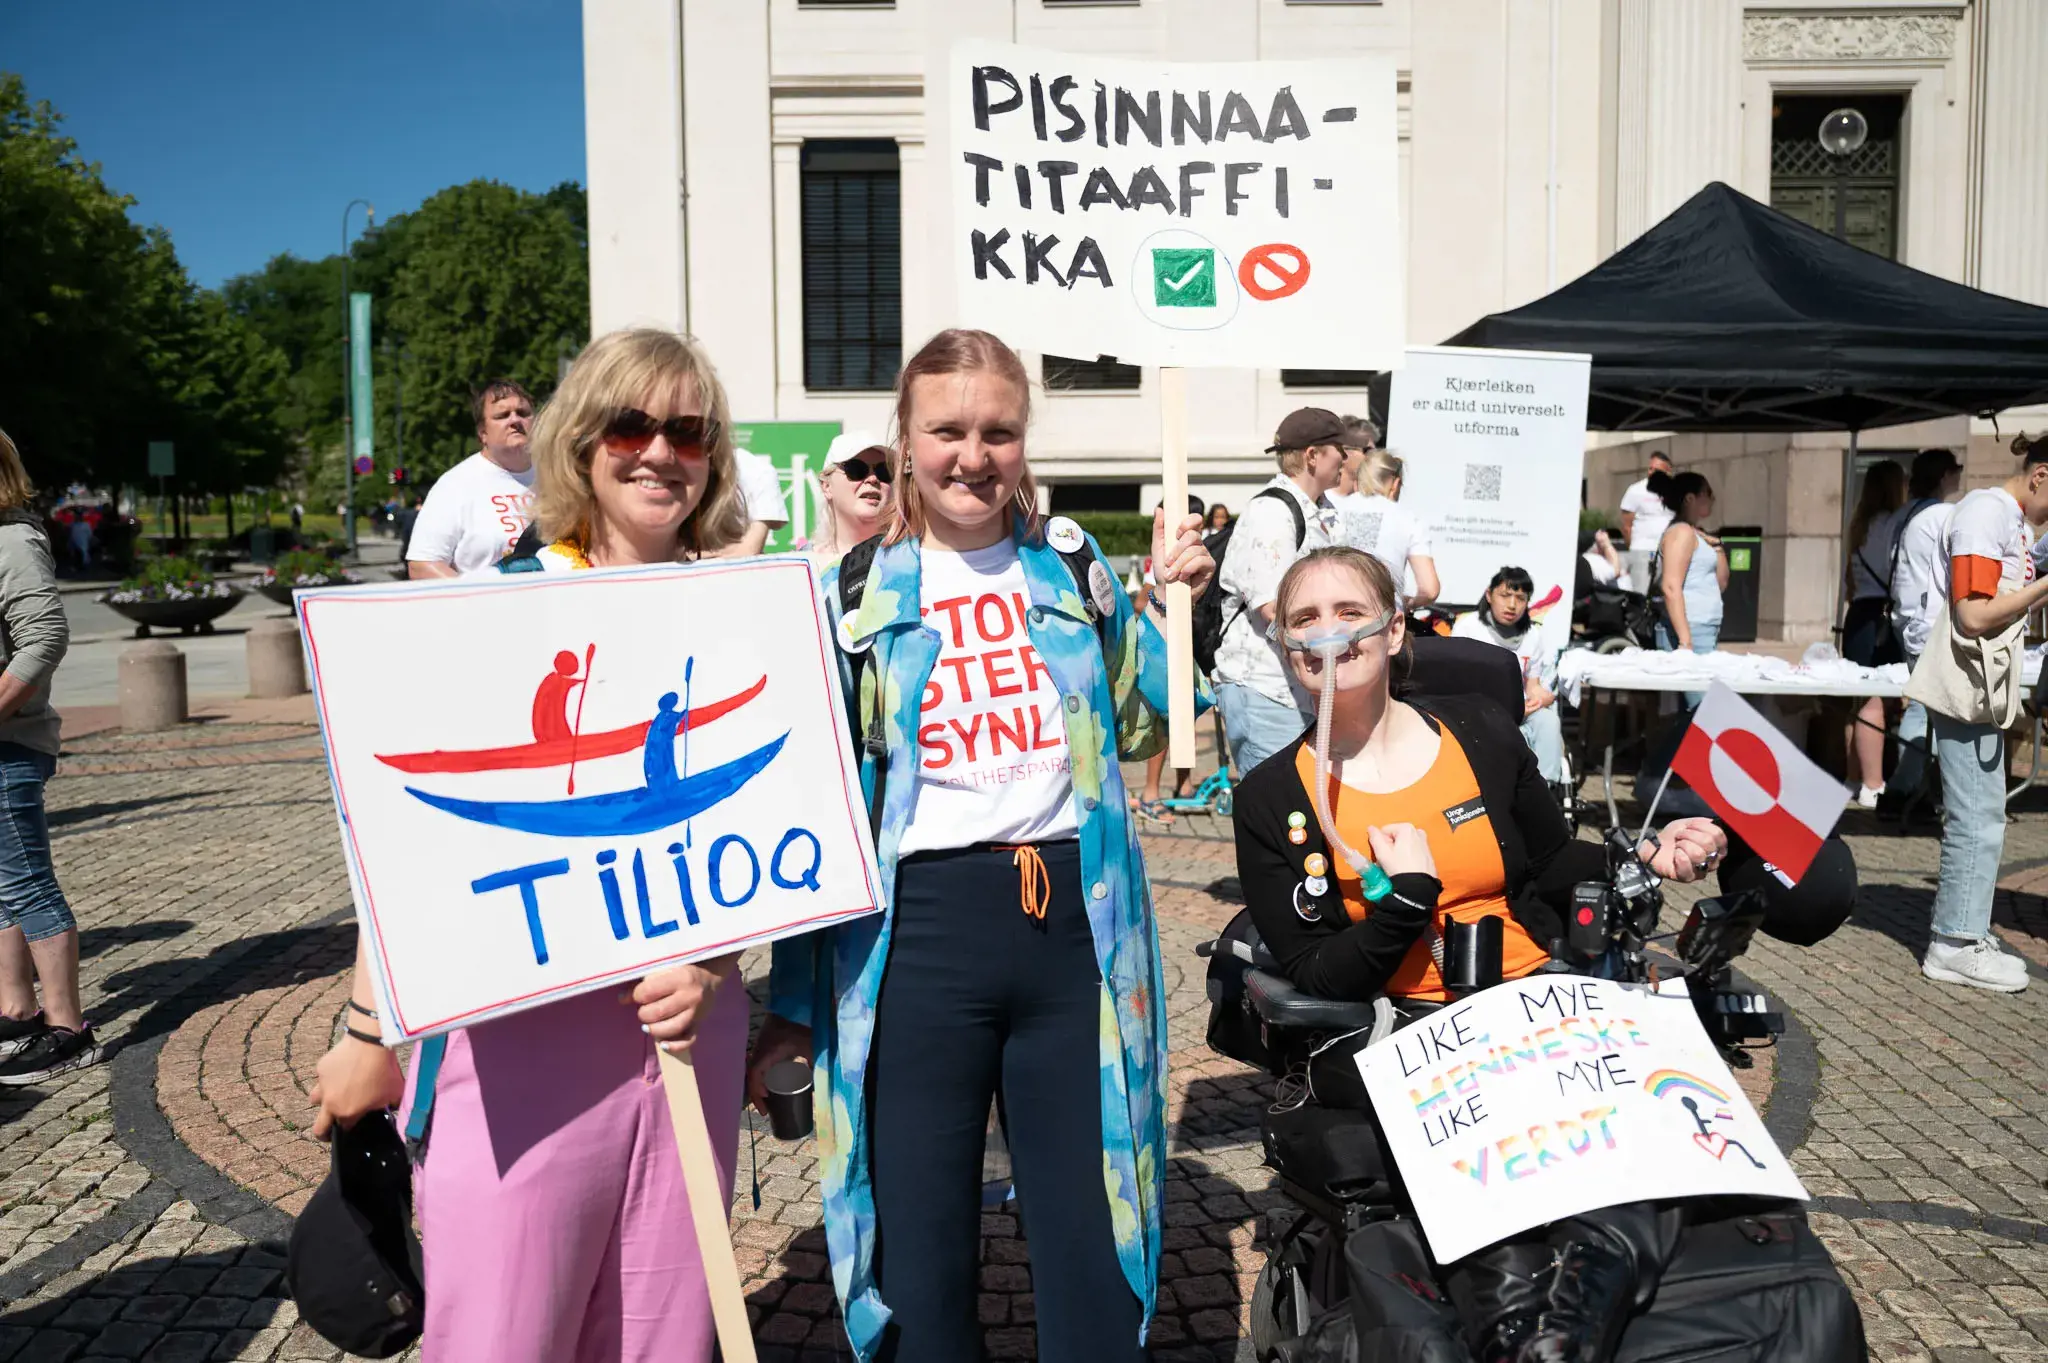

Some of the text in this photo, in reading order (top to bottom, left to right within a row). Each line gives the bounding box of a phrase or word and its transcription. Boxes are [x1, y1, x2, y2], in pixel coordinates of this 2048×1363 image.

[970, 227, 1114, 291] KKA
[1412, 398, 1565, 417] er alltid universelt
[1445, 376, 1535, 395] Kjærleiken
[1454, 421, 1520, 437] utforma
[1395, 982, 1604, 1078] LIKE MYE
[1409, 1017, 1650, 1117] MENNESKE
[1423, 1053, 1636, 1147] LIKE MYE
[1451, 1106, 1618, 1187] VERDT
